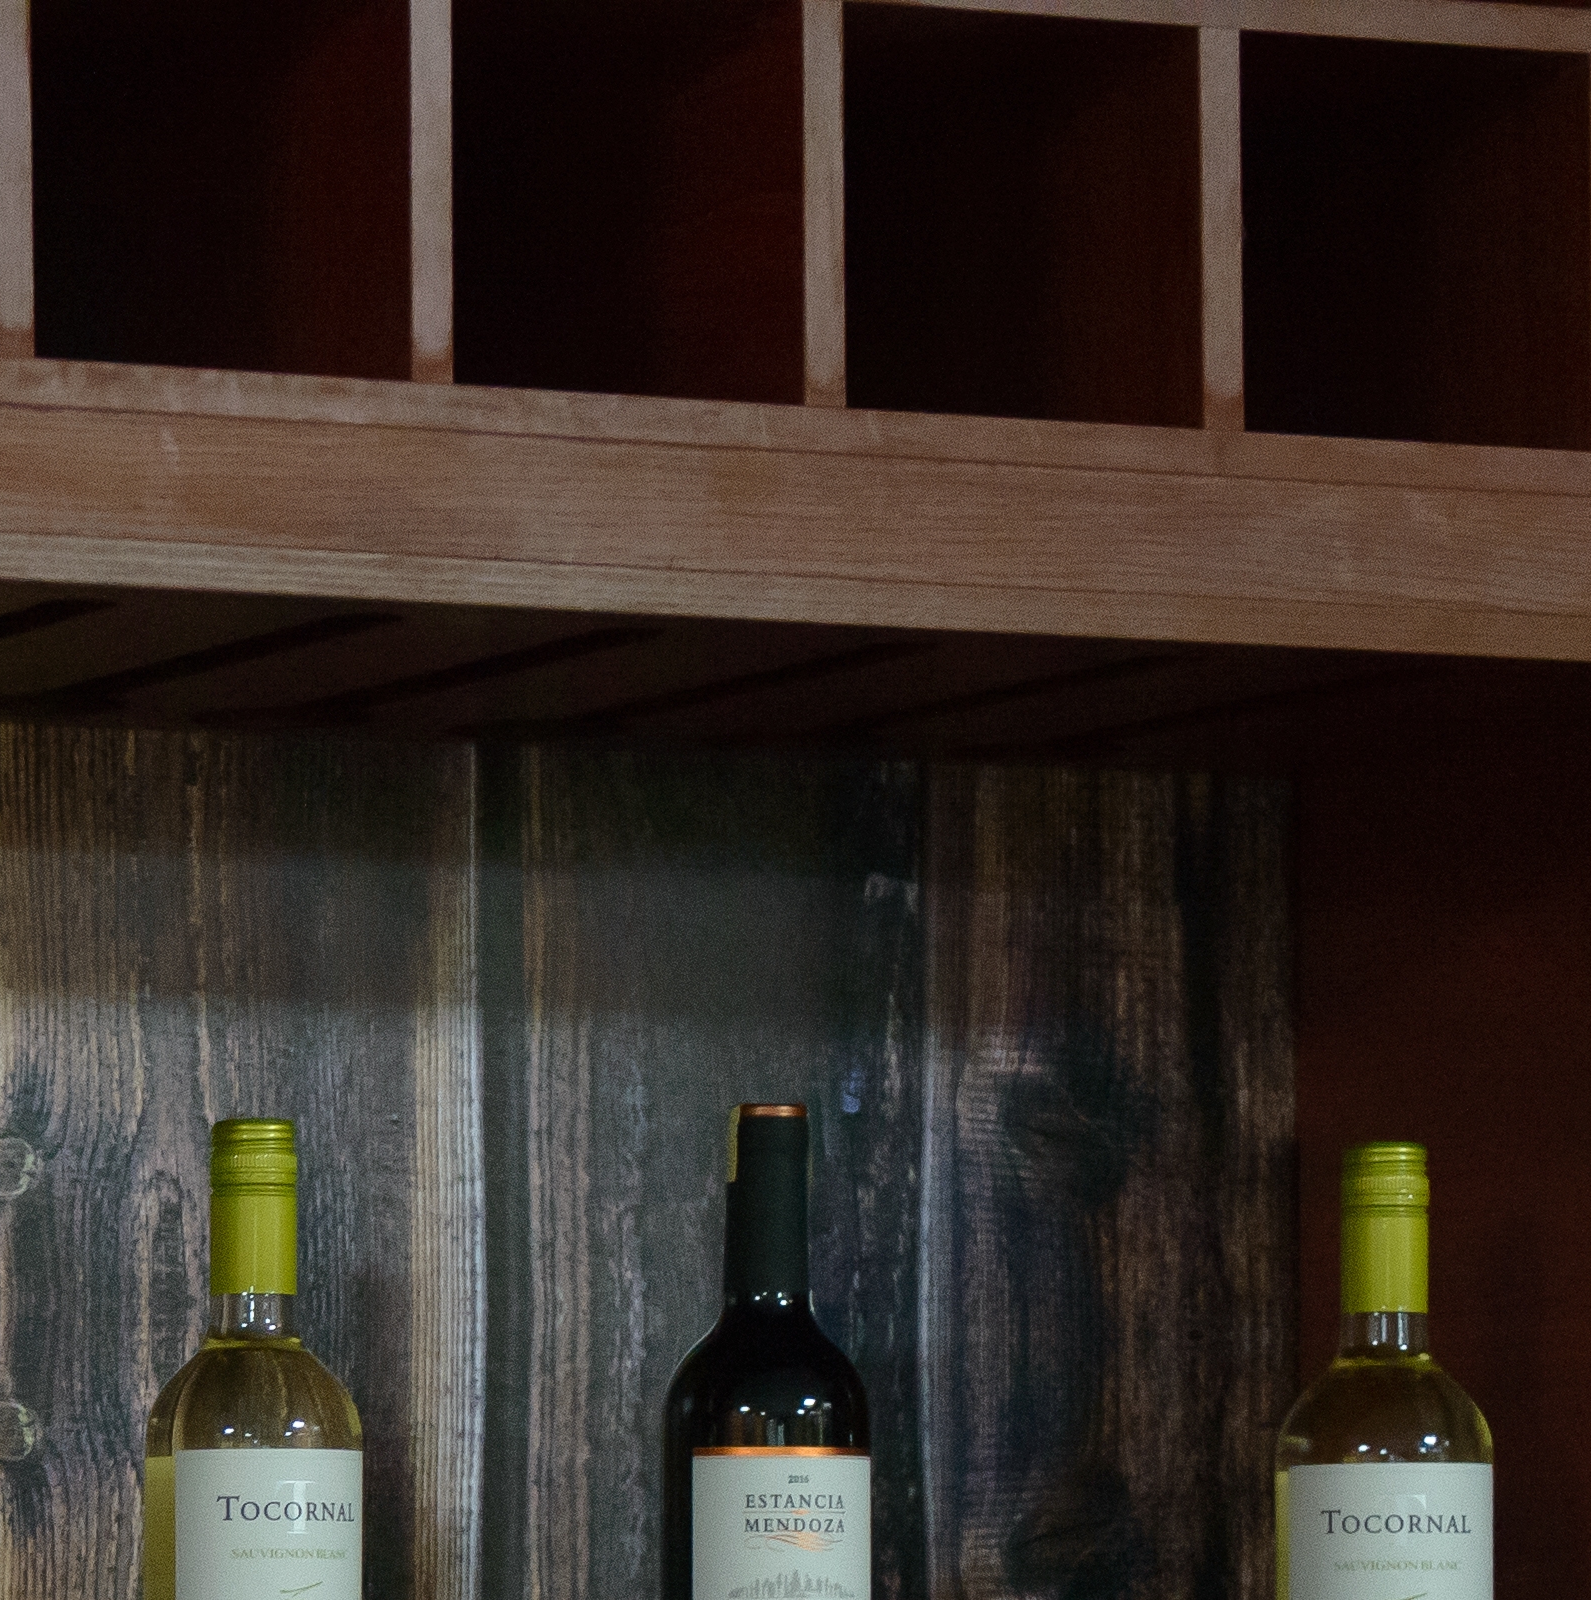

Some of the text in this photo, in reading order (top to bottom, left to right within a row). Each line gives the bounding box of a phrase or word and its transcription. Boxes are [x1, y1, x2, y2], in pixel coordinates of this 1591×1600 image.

[788, 1475, 810, 1484] 2016
[217, 1495, 355, 1522] TOCORNAL
[745, 1494, 845, 1509] ESTANCIA
[744, 1518, 845, 1533] MENDOZA
[1321, 1509, 1471, 1534] TOCORNAL
[230, 1549, 313, 1560] SAUVIGNON
[1334, 1560, 1459, 1571] SAUVIGNON BLANC
